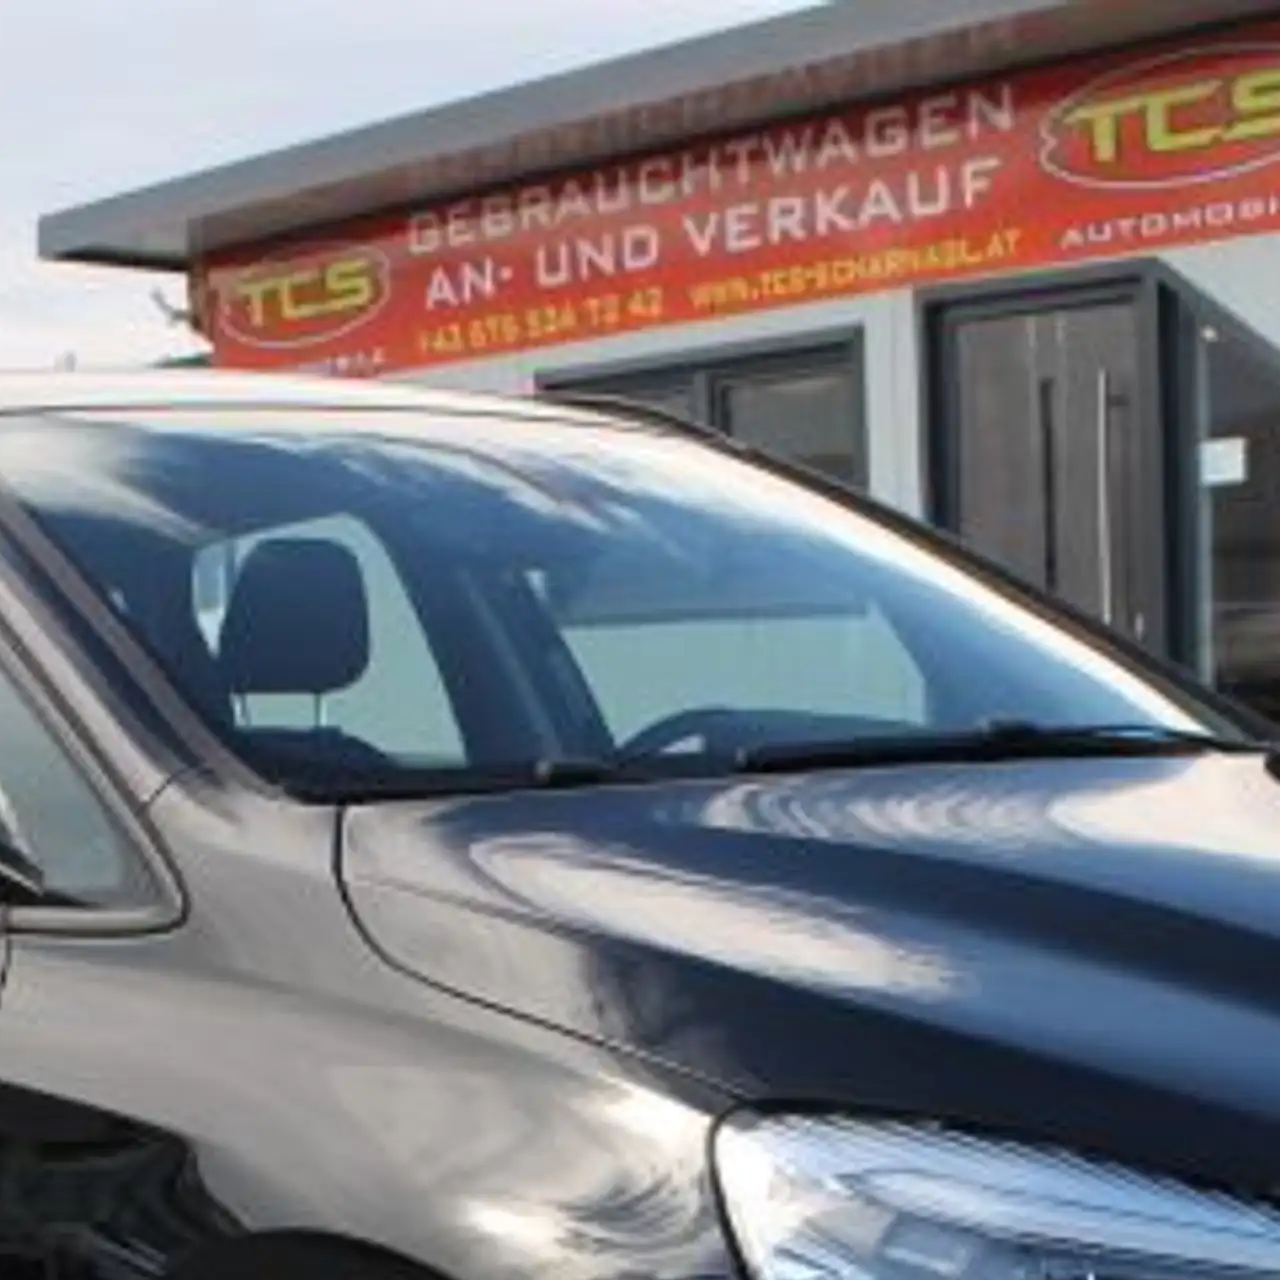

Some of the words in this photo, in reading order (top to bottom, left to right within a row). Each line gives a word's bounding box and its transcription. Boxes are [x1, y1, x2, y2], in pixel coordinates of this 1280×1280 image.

[408, 84, 1013, 256] GEBRAUCHTWAGEN
[424, 260, 513, 311] AN-
[535, 226, 659, 288] UND
[684, 158, 1002, 257] VERKAUF
[235, 257, 372, 329] TCS
